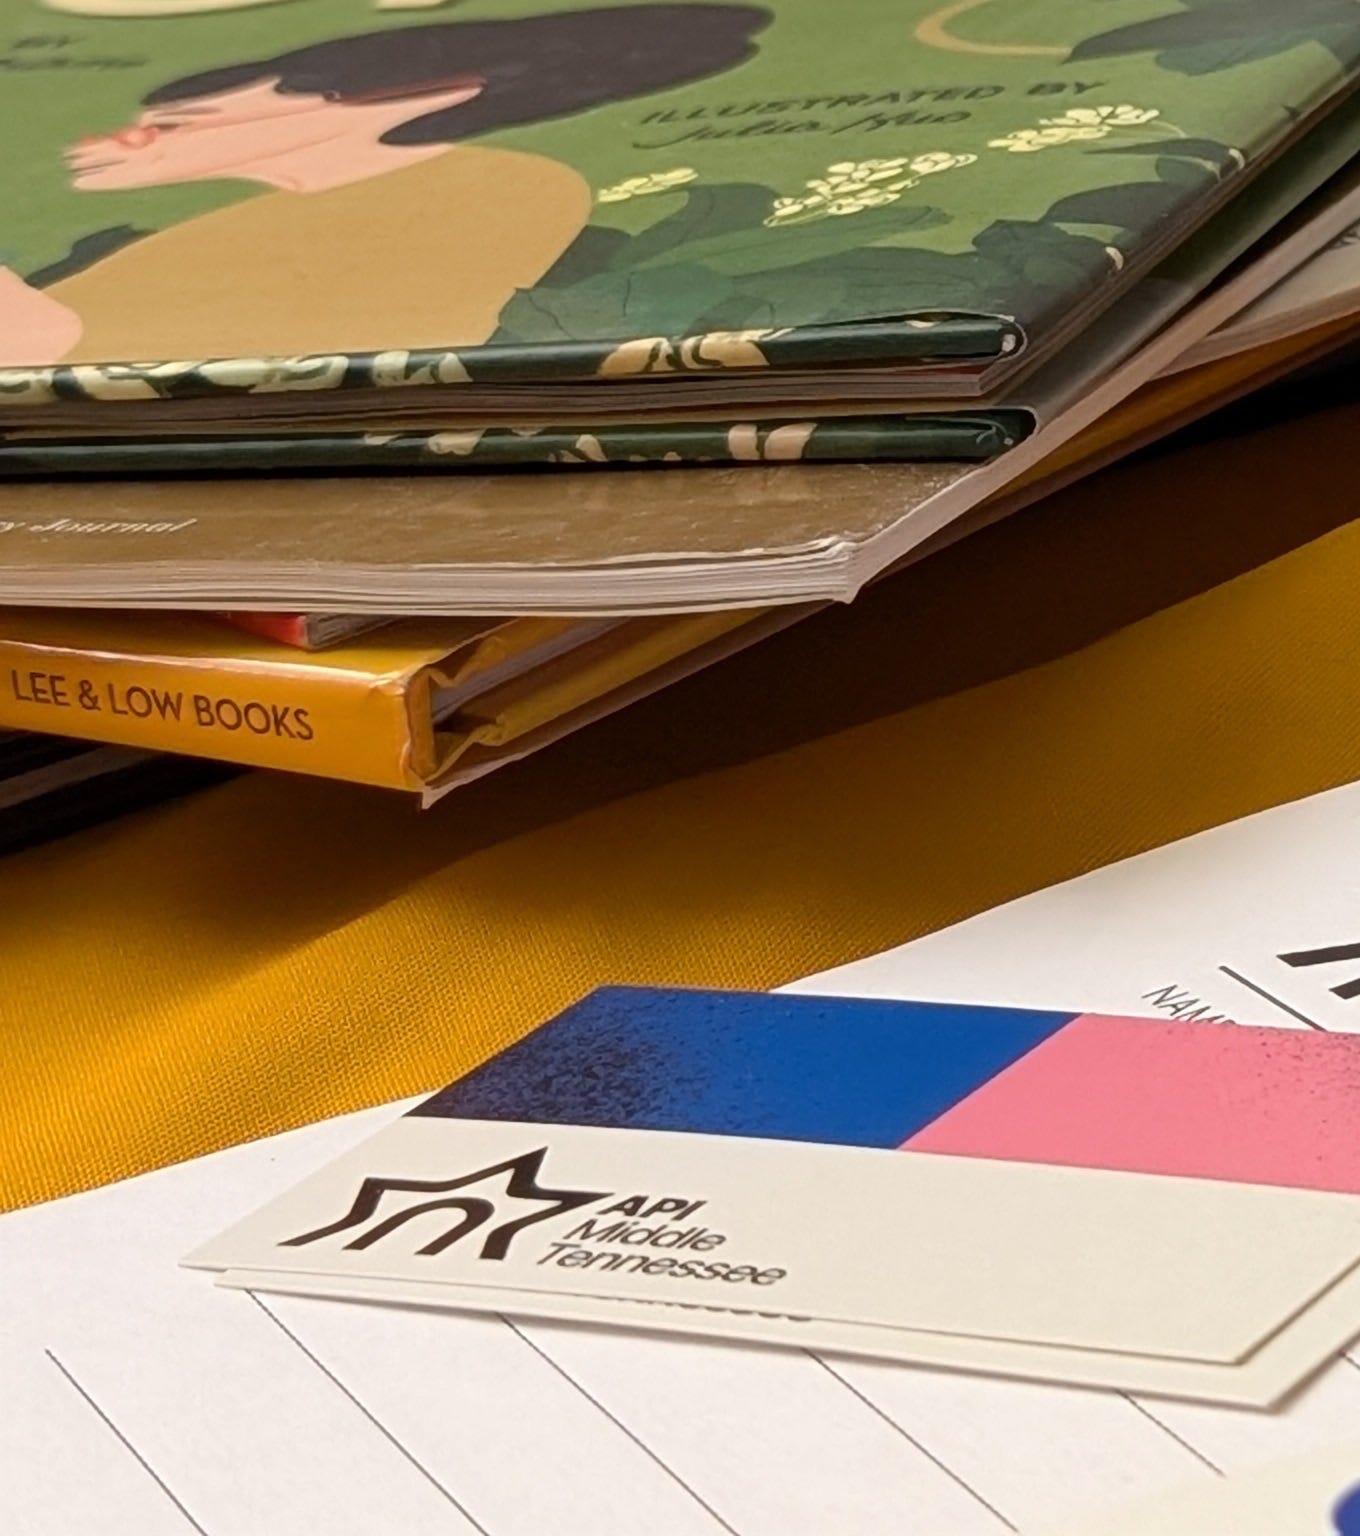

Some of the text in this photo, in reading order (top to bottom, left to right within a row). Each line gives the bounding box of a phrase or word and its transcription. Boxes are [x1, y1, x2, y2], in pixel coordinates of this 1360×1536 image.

[640, 79, 1107, 125] ILLUSTRATED BY
[11, 668, 316, 743] LEE & LOW BOOKS
[596, 1194, 709, 1222] API
[562, 1218, 728, 1252] Middle
[536, 1242, 788, 1287] Tennessee
